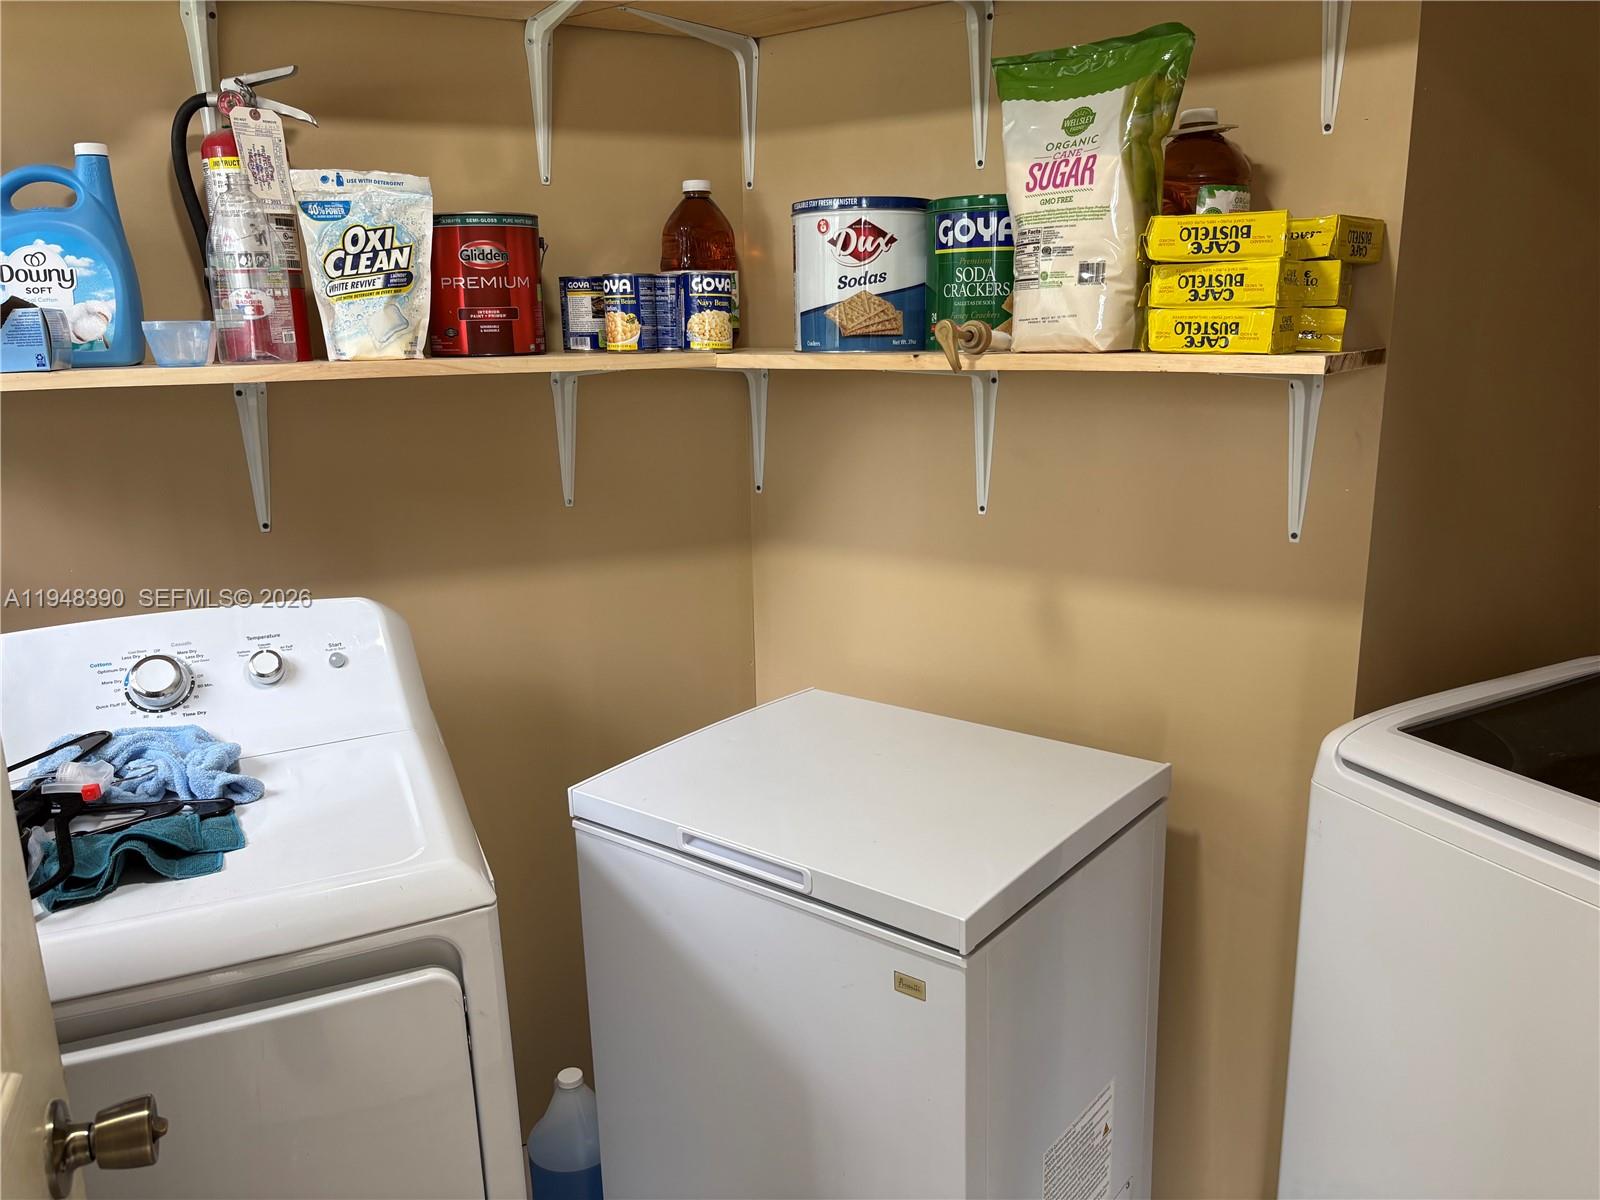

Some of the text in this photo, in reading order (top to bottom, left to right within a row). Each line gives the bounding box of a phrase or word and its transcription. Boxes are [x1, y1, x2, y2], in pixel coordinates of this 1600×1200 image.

[1045, 134, 1099, 152] ORGANIC
[1053, 148, 1083, 160] CANE
[1025, 153, 1098, 193] SUGAR
[818, 199, 833, 207] FRESH
[833, 197, 858, 207] CANISTER
[1040, 196, 1074, 206] GMO FREE
[307, 203, 325, 216] 40%
[938, 216, 1013, 246] GOYA
[1179, 225, 1252, 241] BUSTELO
[1347, 230, 1372, 245] BUSTELO
[343, 224, 394, 255] OXI
[833, 227, 896, 257] Dux
[324, 245, 412, 280] CLEAN
[460, 248, 508, 262] Glidden
[960, 256, 992, 265] Premium
[0, 264, 75, 289] Downy
[837, 270, 887, 290] Sodas
[955, 266, 997, 282] SODA
[1177, 273, 1244, 290] BUSTELO
[329, 282, 349, 294] WHITE
[441, 276, 530, 289] PREMIUM
[568, 281, 590, 289] GOYA
[603, 279, 630, 293] OYA
[692, 276, 731, 293] GOYA
[943, 281, 1010, 298] CRACKERS
[1174, 321, 1239, 336] BUSTELO
[246, 633, 280, 641] Temperature
